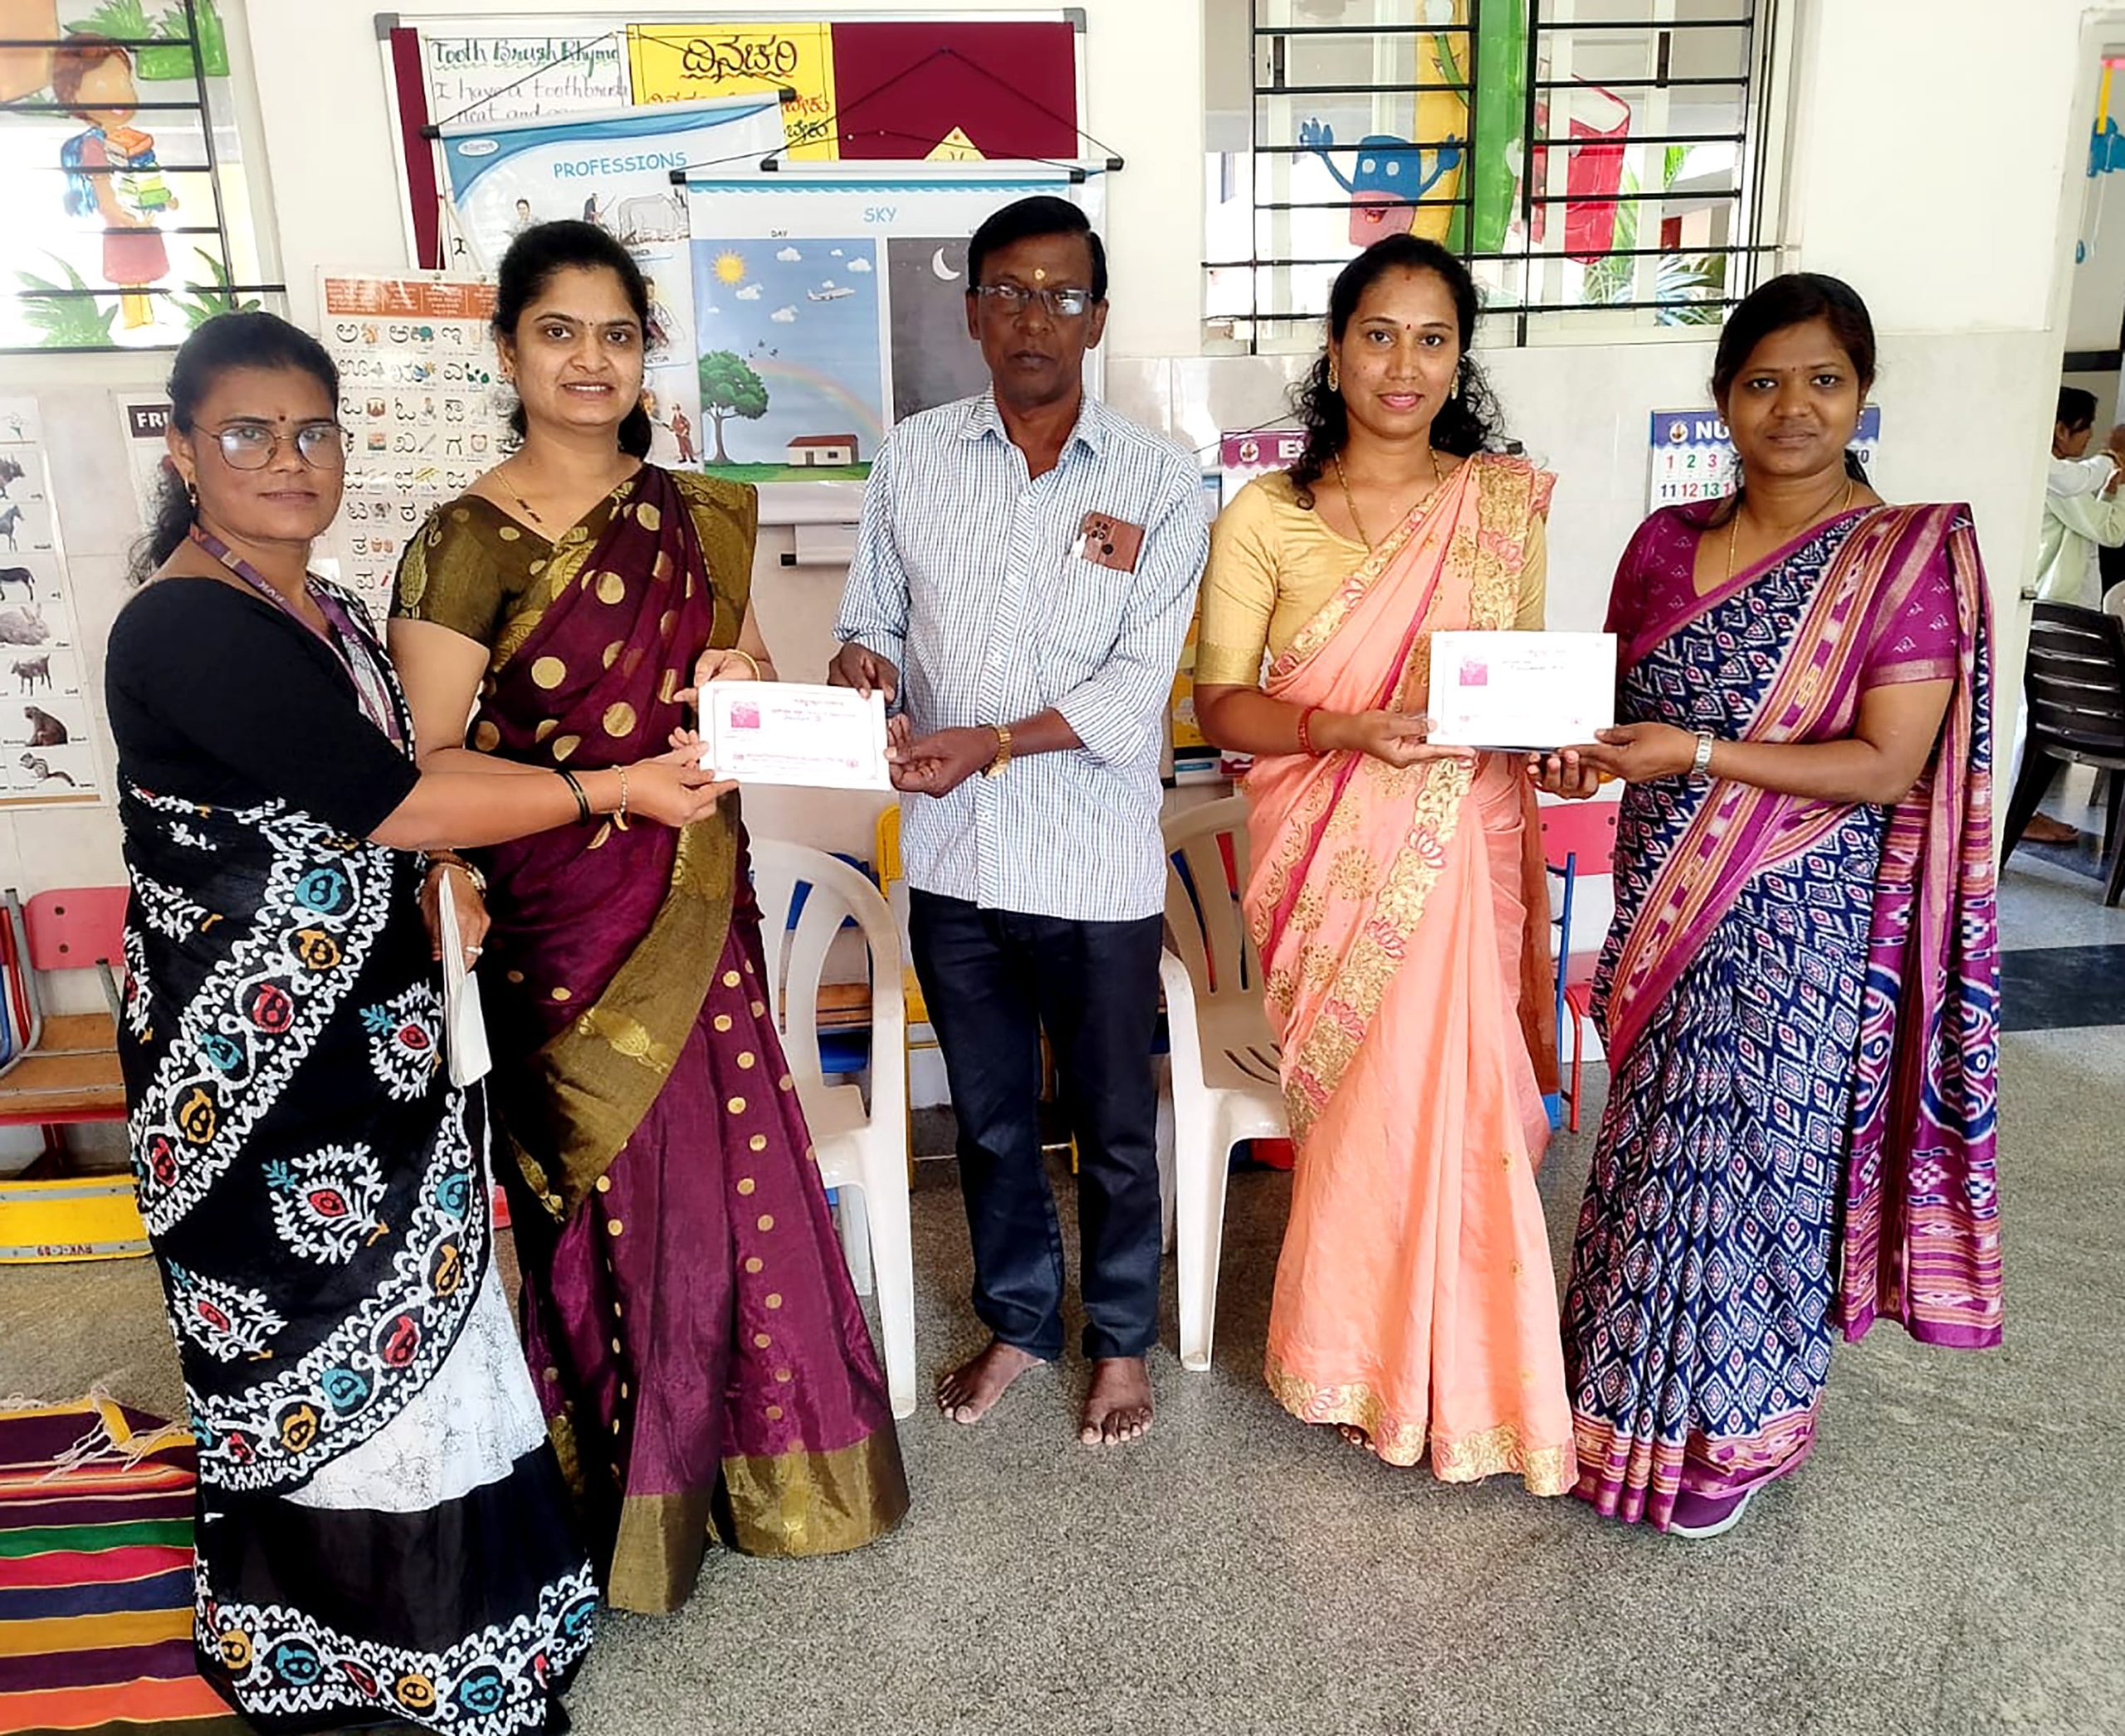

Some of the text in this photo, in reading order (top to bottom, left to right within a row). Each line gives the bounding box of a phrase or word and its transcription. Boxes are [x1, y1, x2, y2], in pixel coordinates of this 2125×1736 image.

[432, 39, 486, 63] Tooth
[493, 38, 557, 61] Brush
[435, 82, 451, 100] I
[554, 152, 687, 178] PROFESSIONS
[863, 208, 897, 223] SKY
[770, 229, 788, 238] DAY
[336, 324, 462, 345] ಅ ಆ ಇ
[446, 435, 462, 456] ಗ
[1666, 454, 1673, 470] 1
[1687, 454, 1696, 468] 2
[1708, 453, 1717, 468] 3
[1660, 483, 1676, 498] 11
[1682, 482, 1698, 498] 12
[1702, 482, 1719, 497] 13
[400, 501, 417, 522] ಠ
